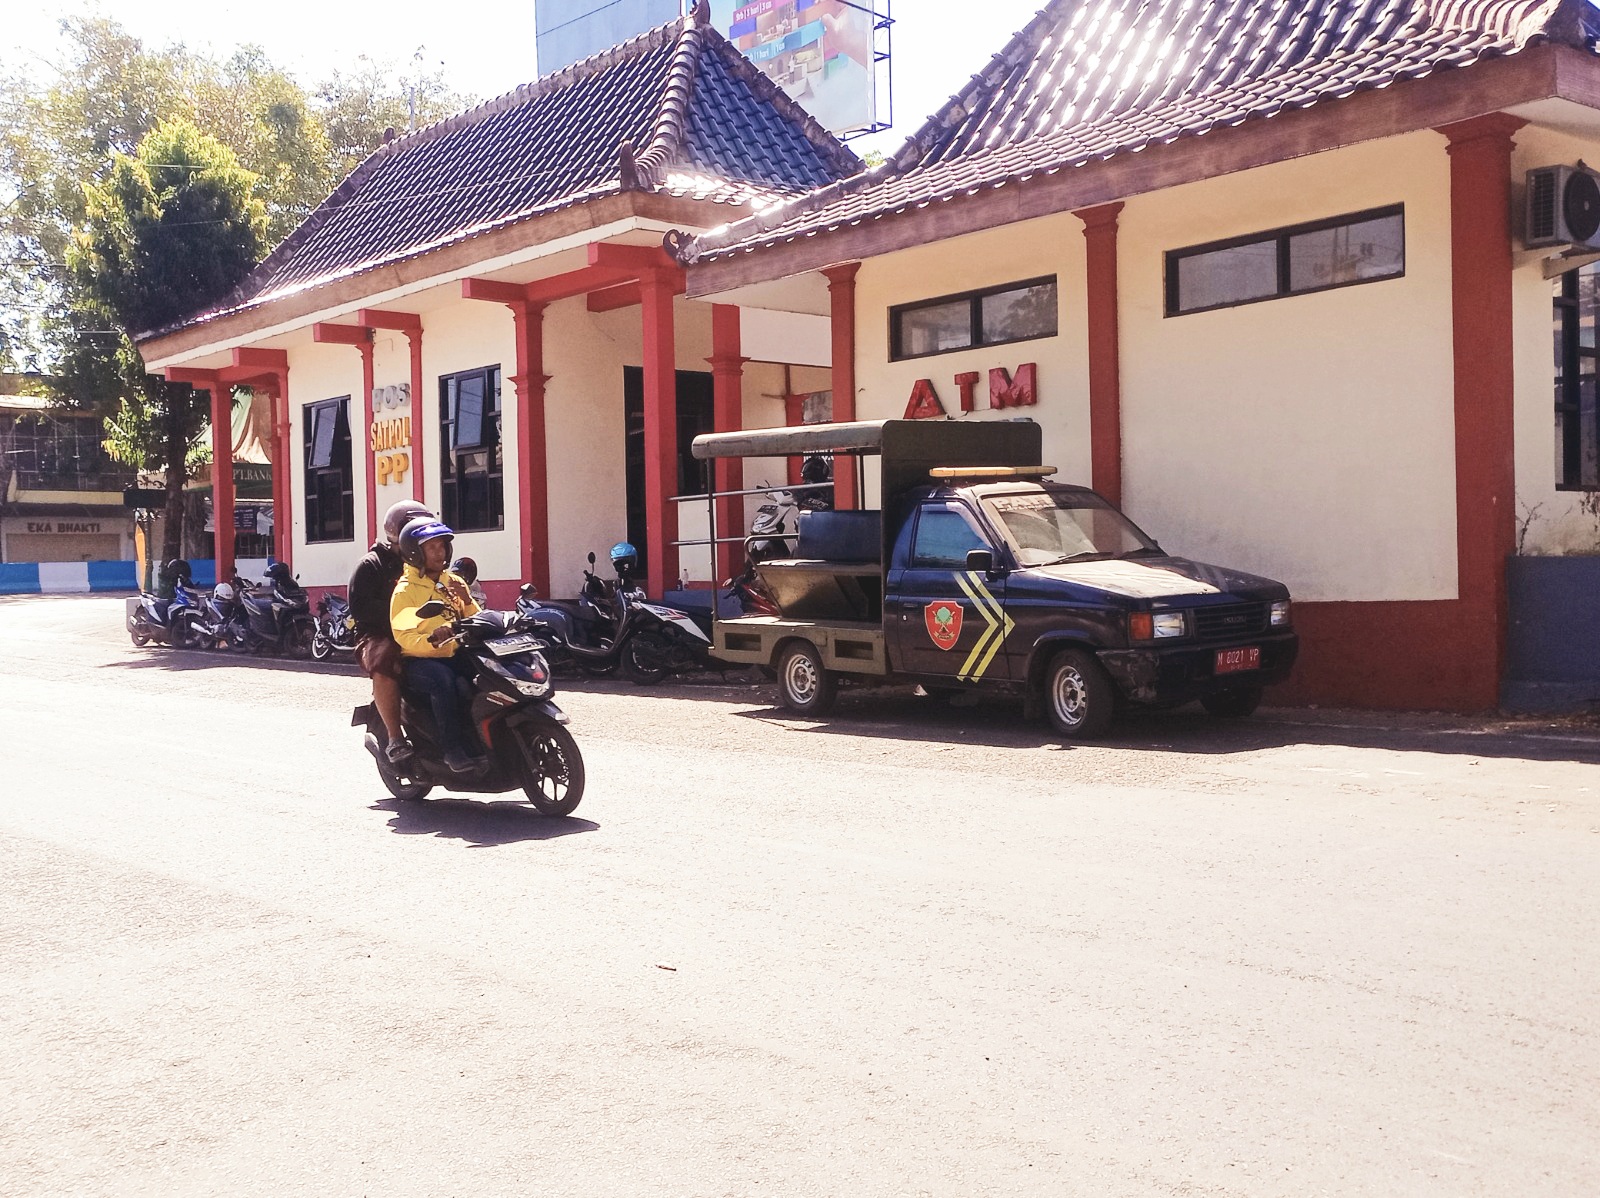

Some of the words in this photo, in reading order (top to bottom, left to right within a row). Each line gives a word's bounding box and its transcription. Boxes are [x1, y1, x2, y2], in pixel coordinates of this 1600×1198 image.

[371, 382, 410, 413] POS
[903, 362, 1038, 419] ATM
[370, 416, 412, 452] SATPOL
[377, 452, 409, 486] PP
[27, 521, 52, 533] EKA
[57, 522, 101, 533] BHAKTI
